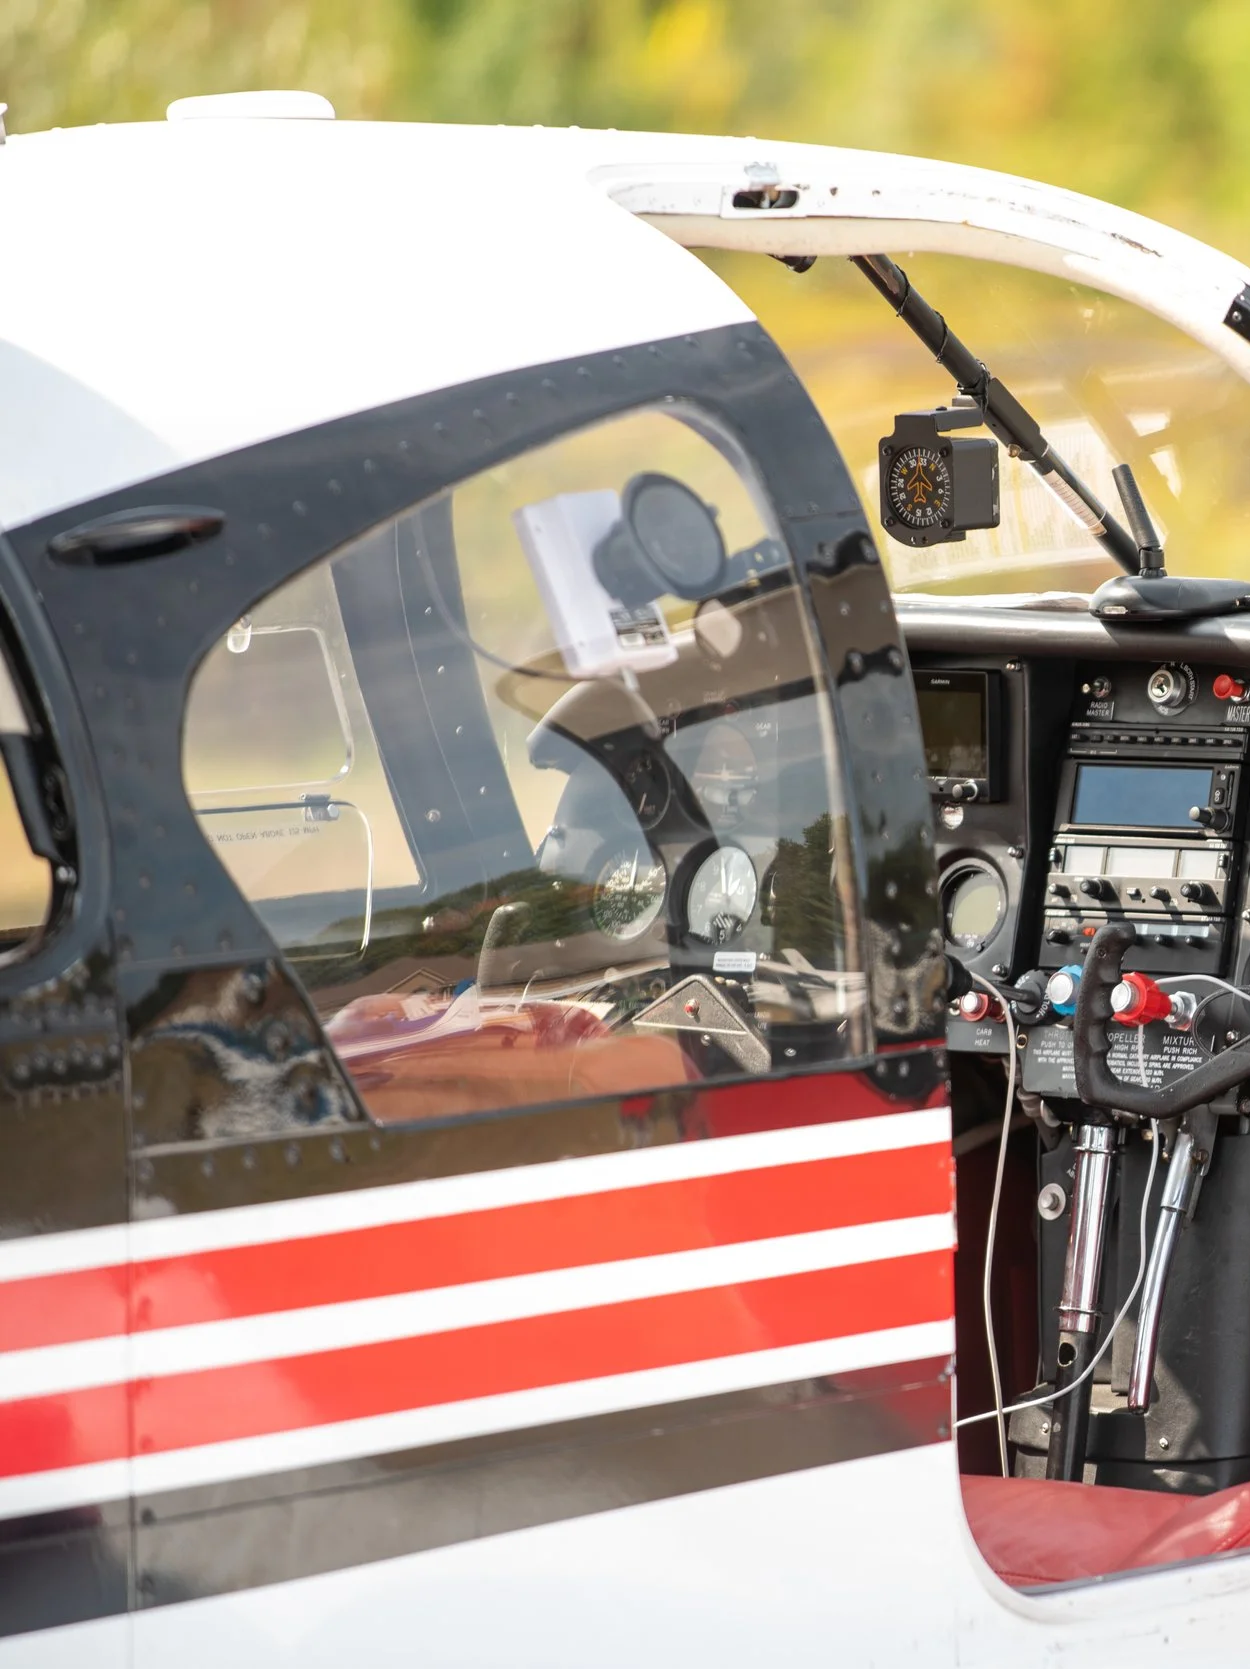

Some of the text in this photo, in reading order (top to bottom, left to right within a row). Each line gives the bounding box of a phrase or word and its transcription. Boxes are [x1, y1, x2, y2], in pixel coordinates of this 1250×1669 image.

[908, 458, 916, 468] 30
[920, 457, 928, 466] 33
[900, 466, 908, 475] W
[929, 462, 936, 472] N
[898, 478, 904, 488] 24
[906, 504, 912, 512] S
[934, 500, 942, 508] E
[916, 508, 922, 516] 15
[926, 506, 932, 516] 12
[1086, 708, 1110, 717] MASTER
[1226, 706, 1250, 722] MASTER
[976, 1028, 992, 1036] CARB
[1162, 1035, 1194, 1046] MIXTUR
